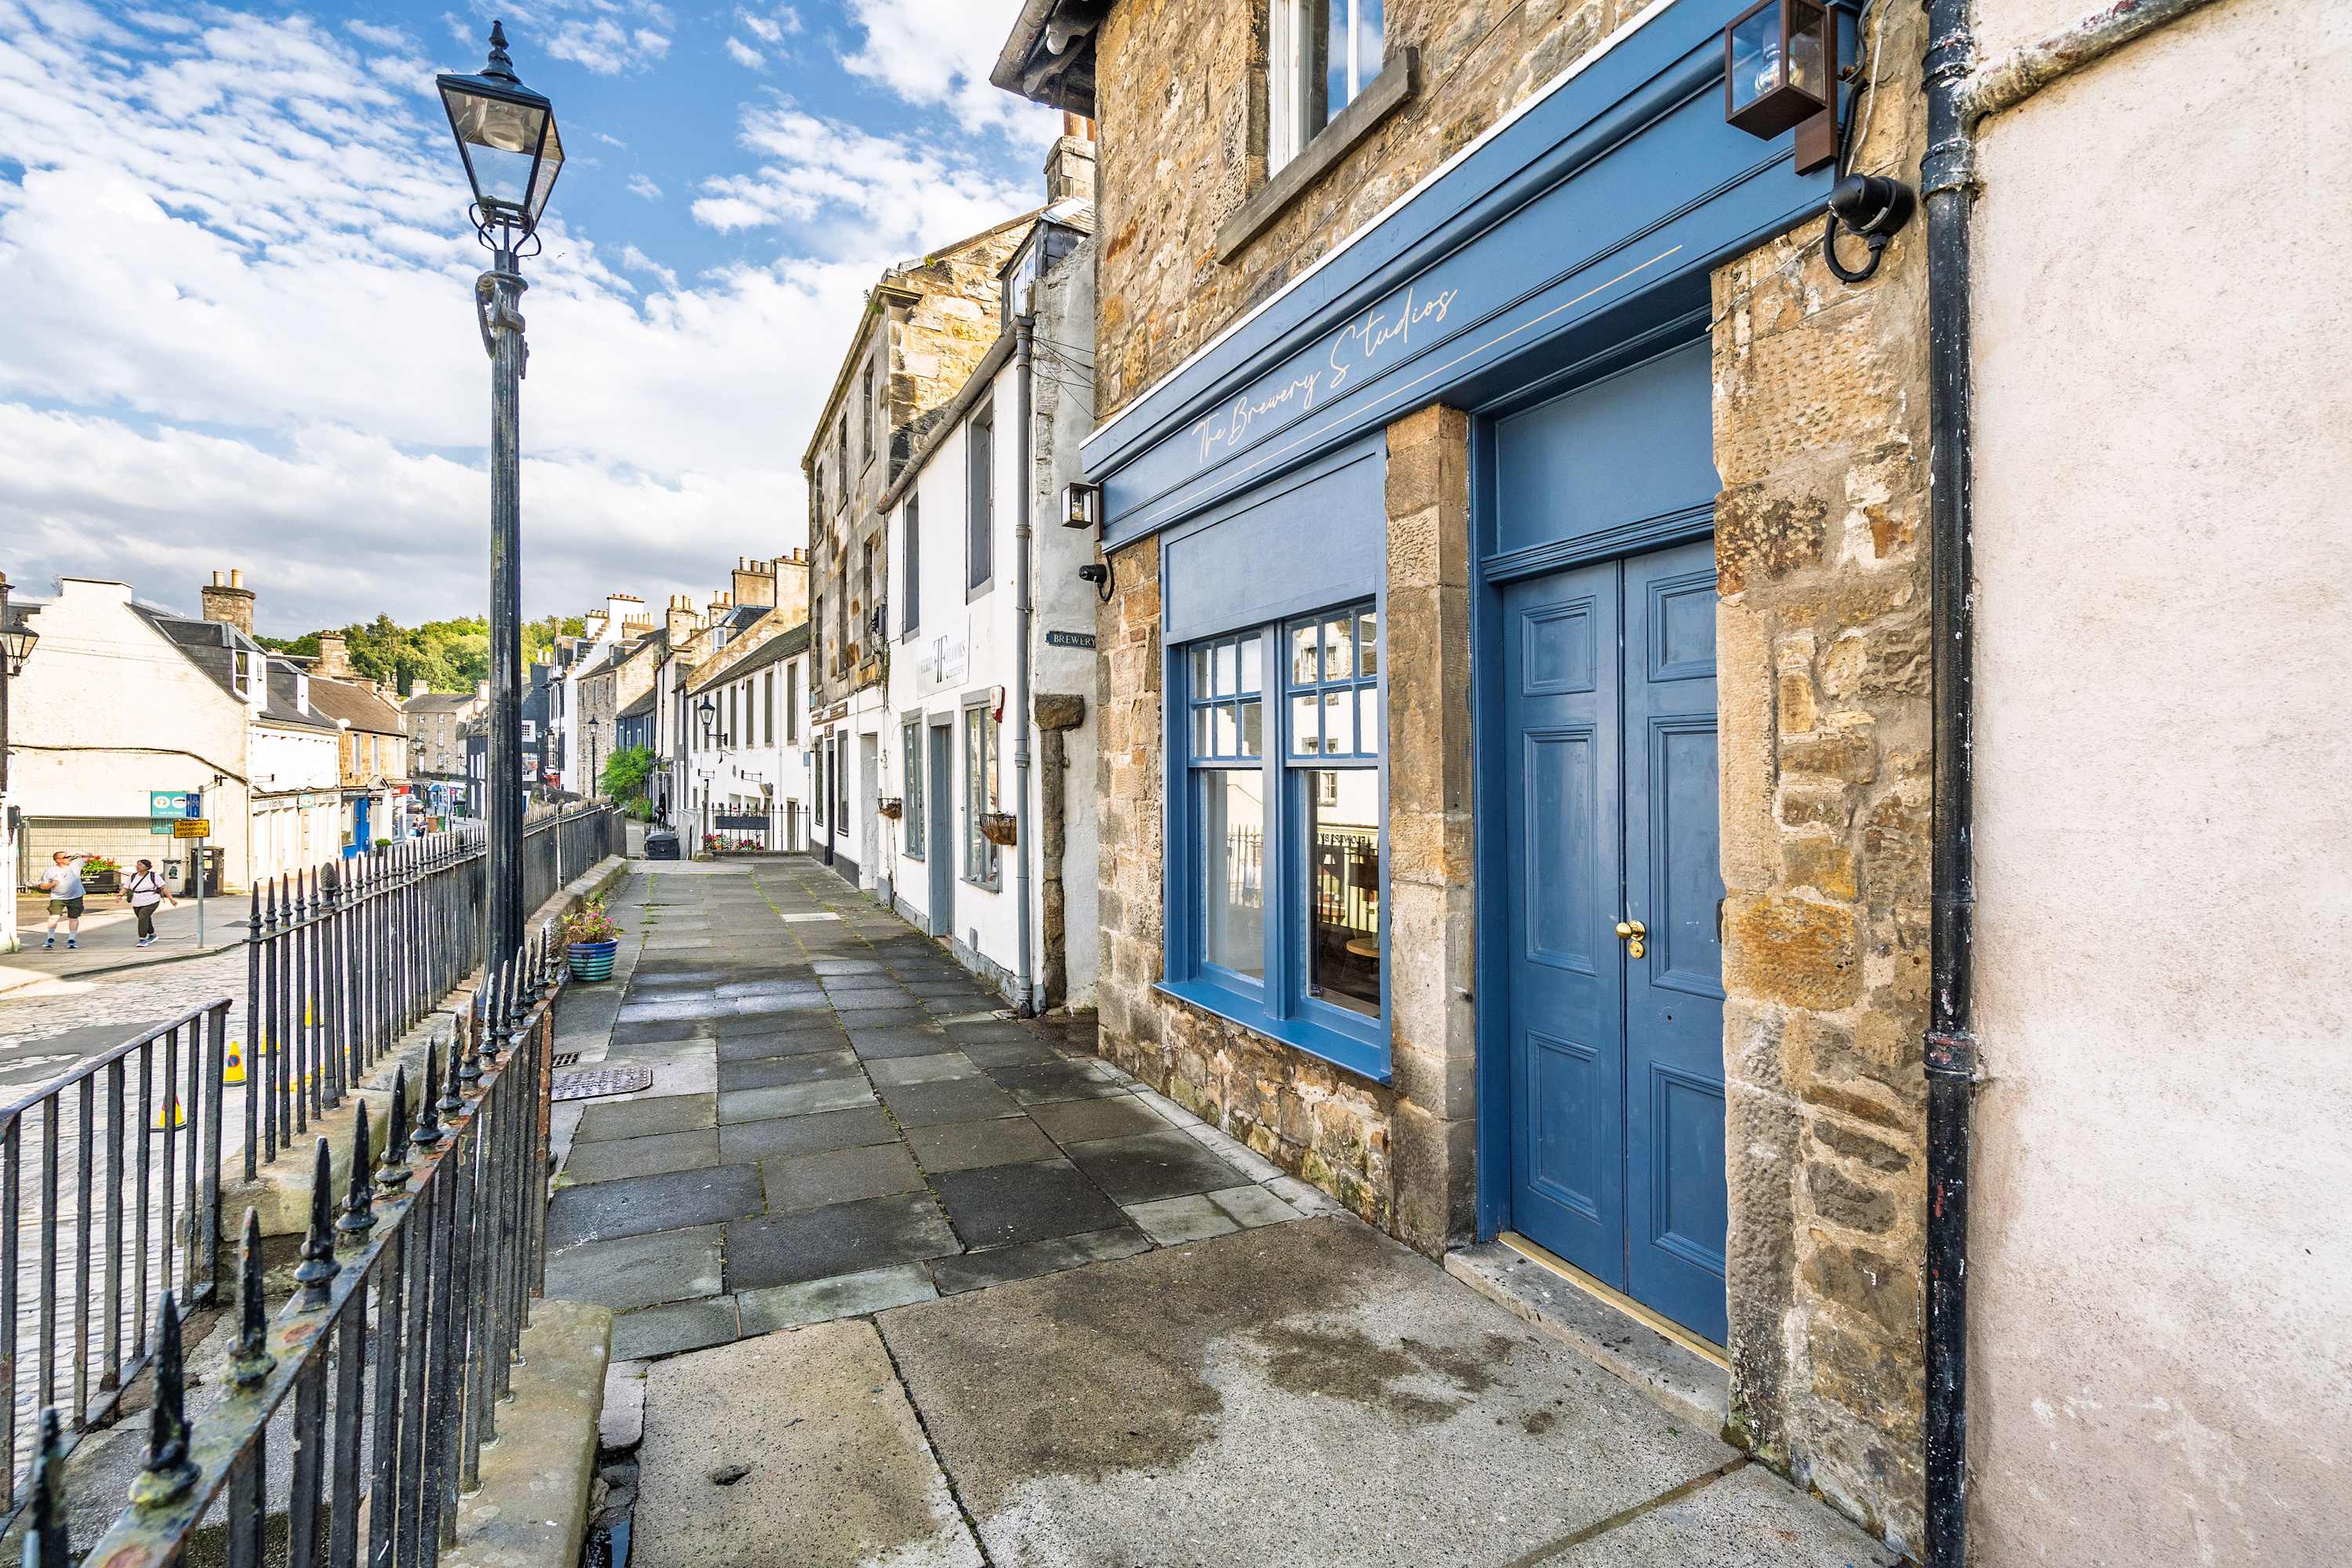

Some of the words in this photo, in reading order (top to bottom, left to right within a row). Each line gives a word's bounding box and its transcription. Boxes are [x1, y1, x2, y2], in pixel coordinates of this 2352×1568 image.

[1192, 412, 1227, 463] The
[1228, 370, 1322, 445] Brewery
[1330, 287, 1459, 389] Studios
[1054, 633, 1096, 647] BREWERY
